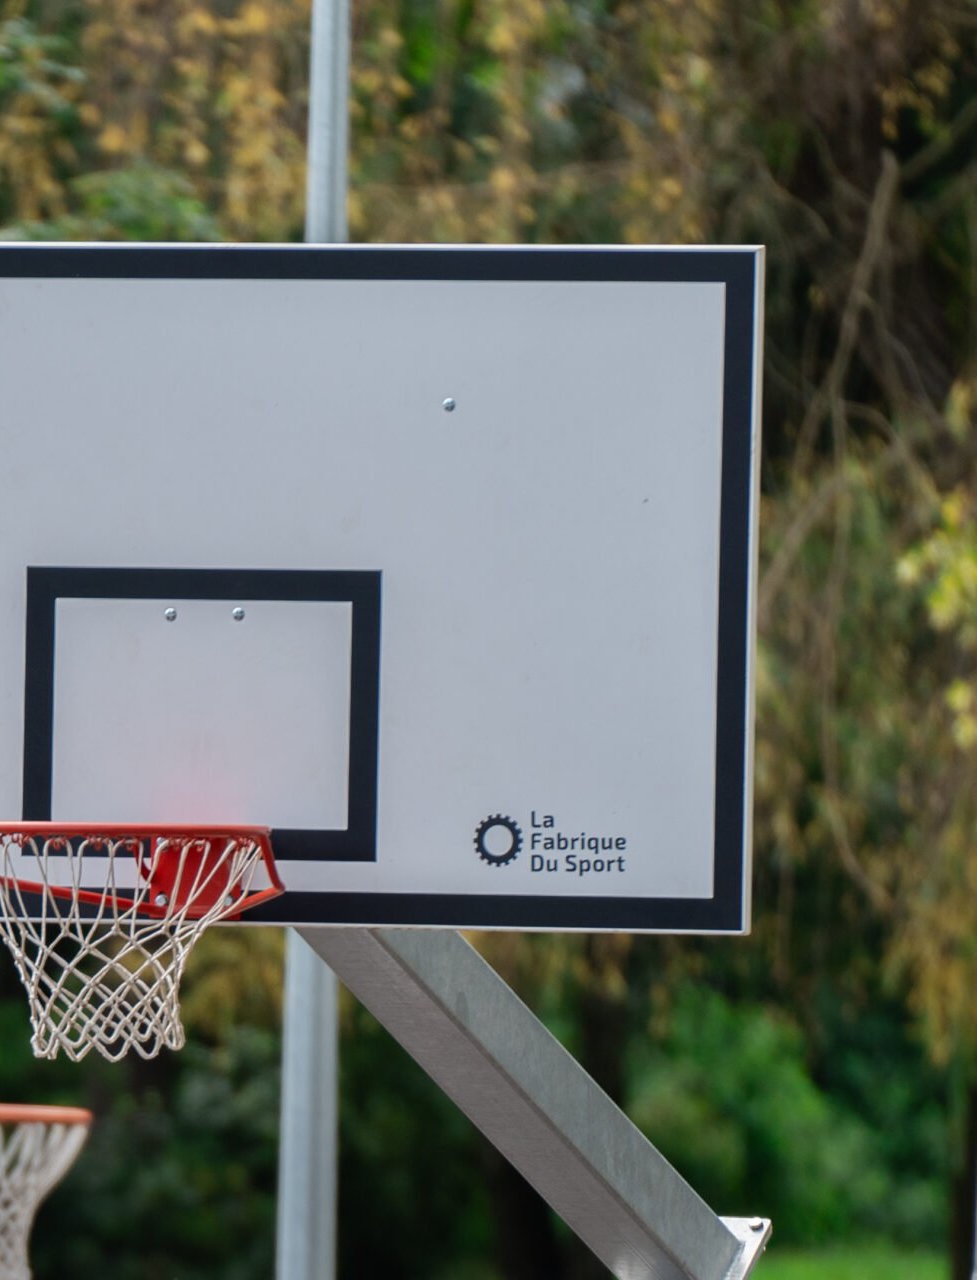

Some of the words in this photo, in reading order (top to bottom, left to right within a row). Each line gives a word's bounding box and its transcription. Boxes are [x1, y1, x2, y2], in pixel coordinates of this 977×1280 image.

[530, 810, 555, 828] La
[530, 832, 627, 855] Fabrique
[530, 854, 558, 872] Du
[565, 854, 626, 876] Sport
